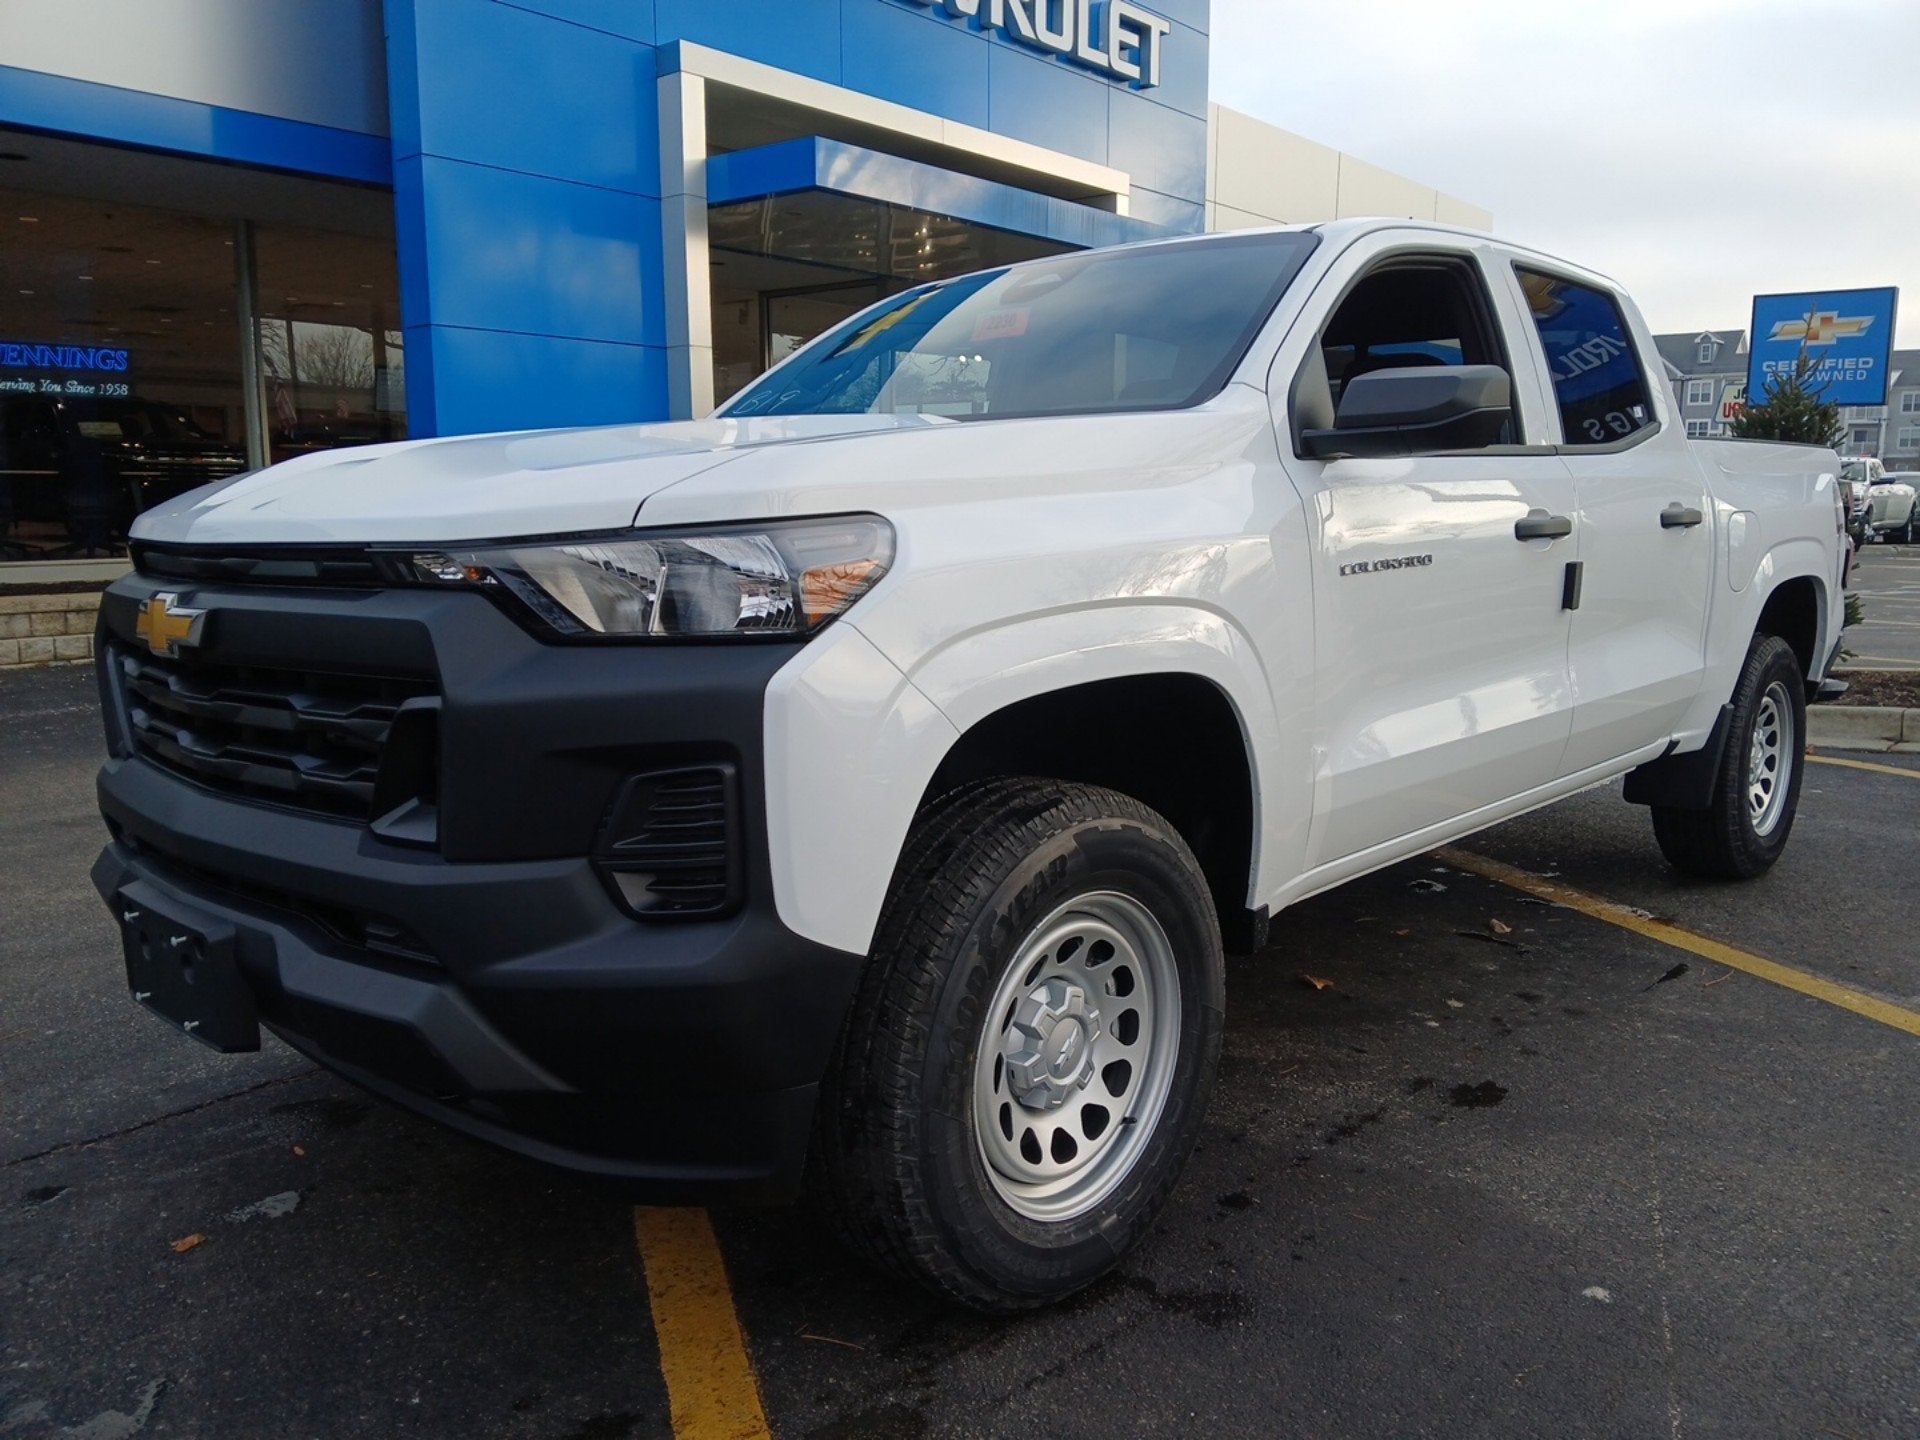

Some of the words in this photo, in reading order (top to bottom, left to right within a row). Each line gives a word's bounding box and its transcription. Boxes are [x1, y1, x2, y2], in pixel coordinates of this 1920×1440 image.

[920, 0, 1171, 87] ROLET
[0, 378, 36, 394] erving
[40, 379, 62, 393] You
[65, 380, 96, 394] Since
[100, 383, 129, 396] 1958
[1339, 554, 1433, 577] COLORADO
